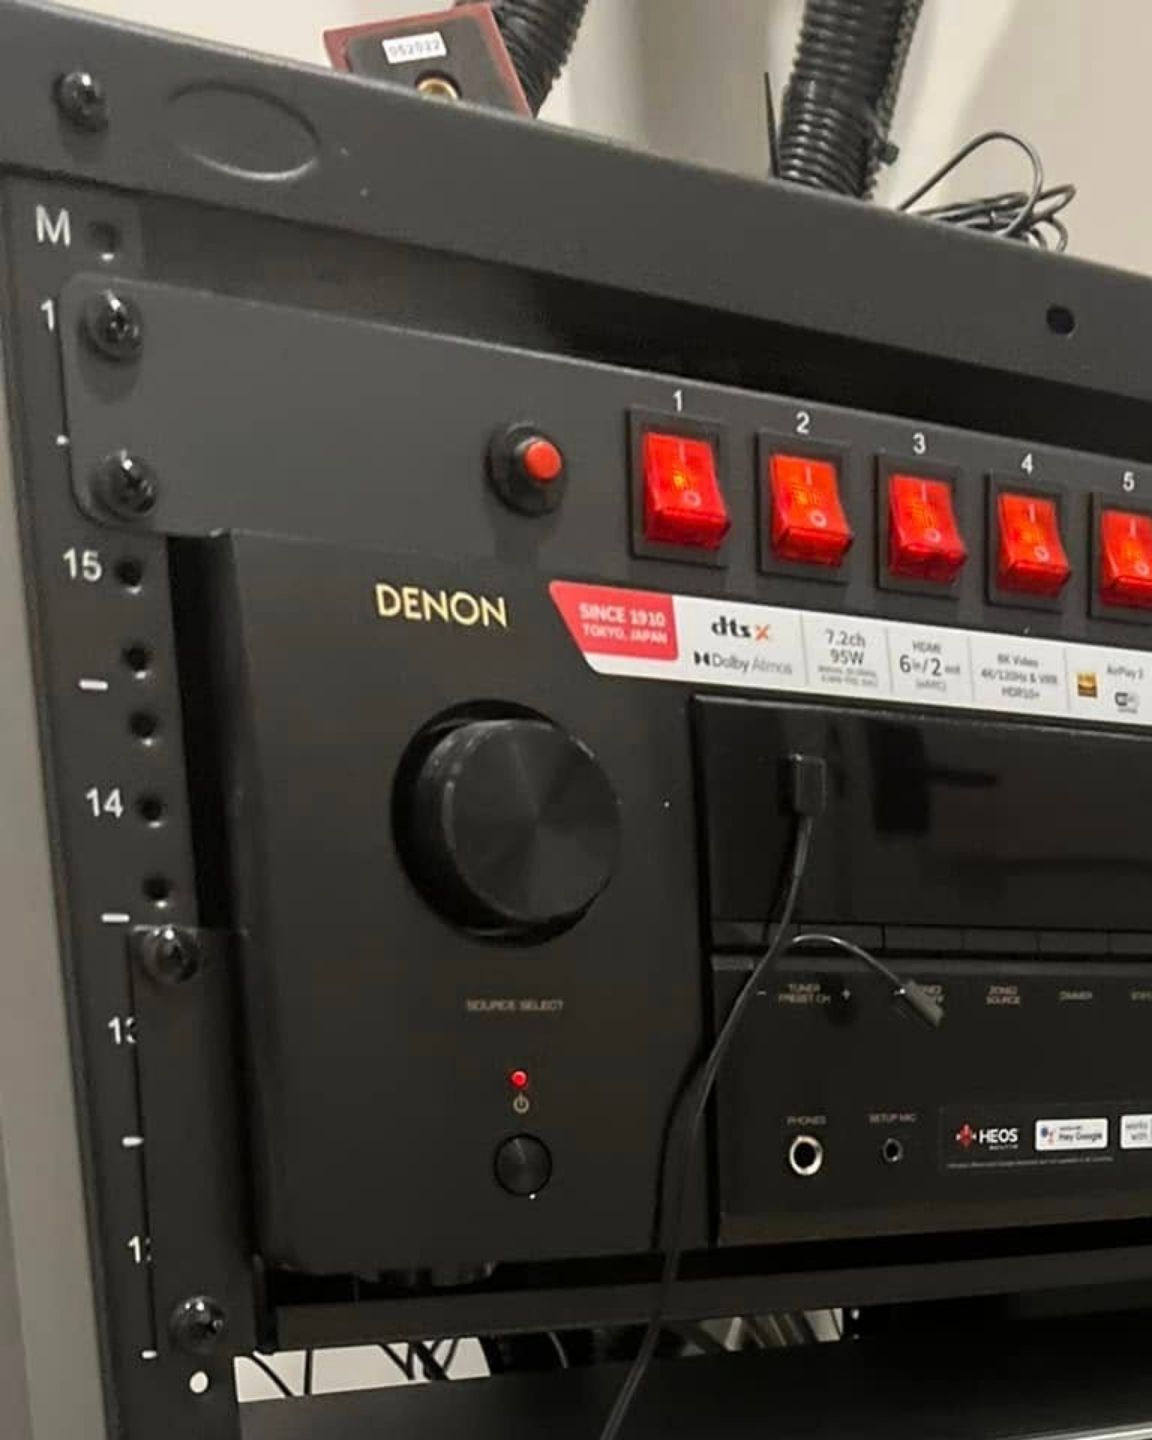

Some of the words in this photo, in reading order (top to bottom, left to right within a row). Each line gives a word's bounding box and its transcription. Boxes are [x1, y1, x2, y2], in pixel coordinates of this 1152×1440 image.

[35, 204, 71, 247] M
[673, 389, 682, 412] 1
[796, 412, 810, 434] 2
[912, 432, 926, 454] 3
[1021, 453, 1033, 475] 4
[1123, 471, 1135, 491] 5
[63, 549, 102, 582] 15
[375, 582, 506, 628] DENON
[579, 603, 625, 622] SINCE
[630, 610, 666, 628] 1910
[630, 629, 668, 645] JAPAN
[826, 628, 866, 647] 7.2ch
[712, 653, 749, 672] Dolby
[750, 658, 793, 675] Atmos
[829, 650, 864, 665] 95W
[85, 787, 124, 818] 14
[979, 1128, 1019, 1144] HEOS
